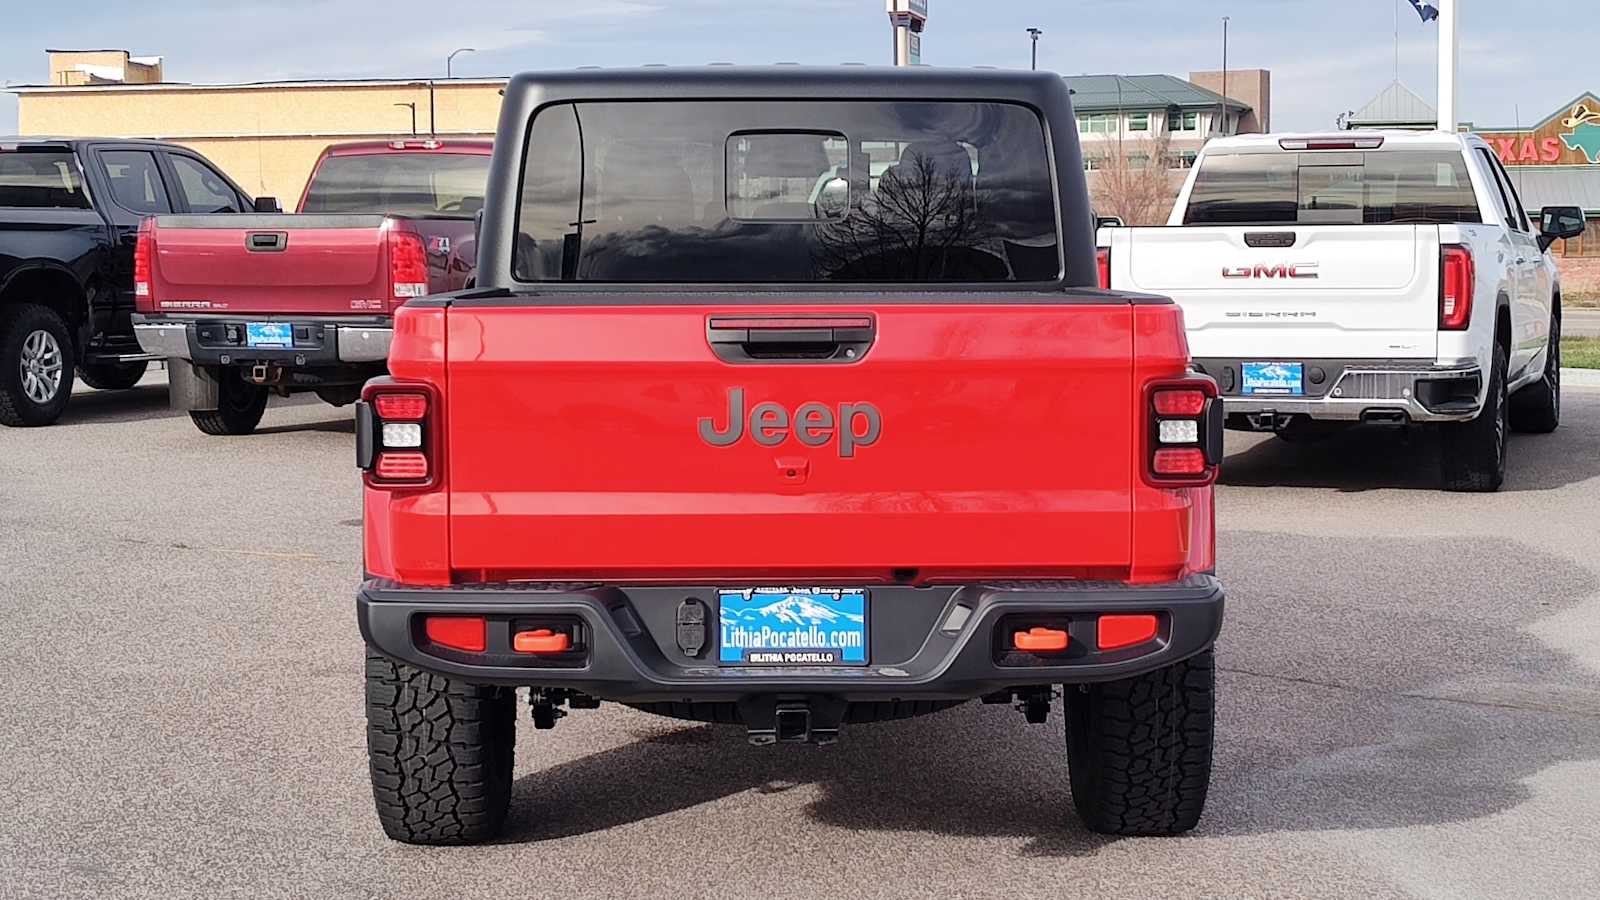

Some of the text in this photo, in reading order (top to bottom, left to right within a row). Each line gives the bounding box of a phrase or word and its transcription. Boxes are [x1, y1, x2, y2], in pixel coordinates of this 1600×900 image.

[1486, 137, 1560, 162] XAS
[1222, 261, 1319, 279] GMC
[698, 387, 882, 458] Jeep
[722, 625, 861, 648] LithiaPocatello.com
[784, 653, 834, 663] POCATELLO
